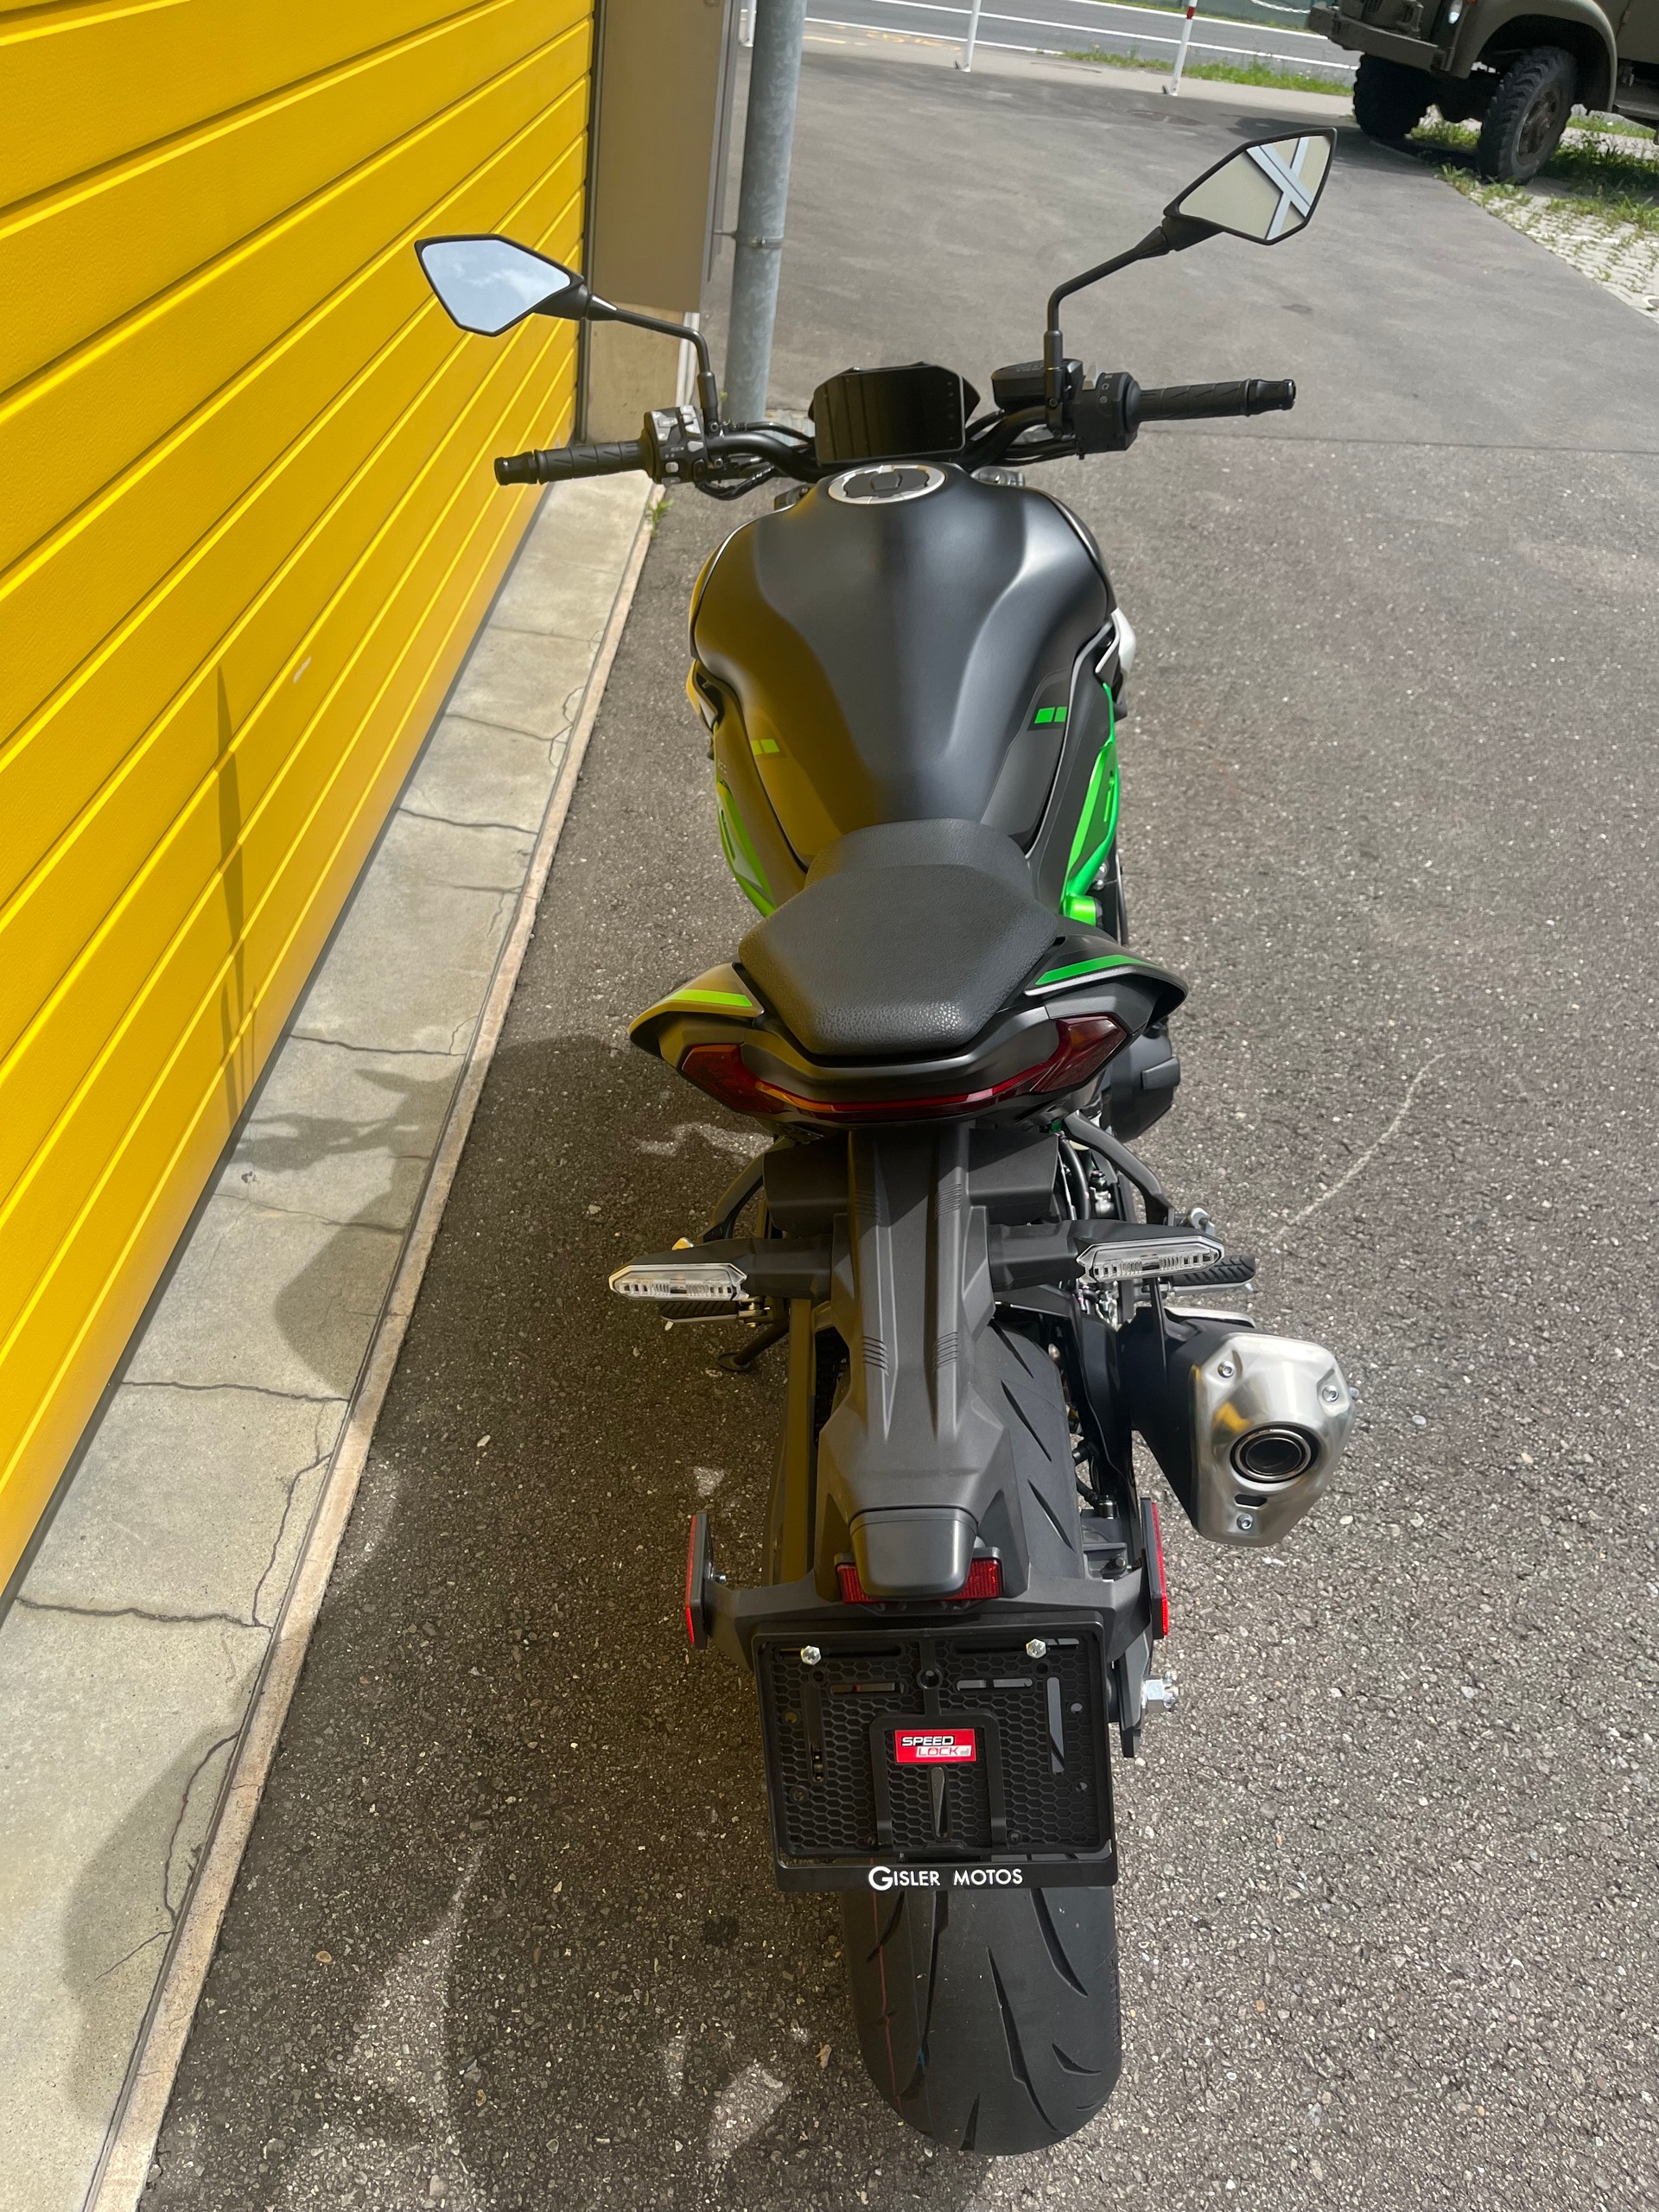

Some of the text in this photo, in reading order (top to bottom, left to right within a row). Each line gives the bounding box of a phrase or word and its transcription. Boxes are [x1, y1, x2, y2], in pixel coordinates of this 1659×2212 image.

[901, 1736, 955, 1746] SPEED
[918, 1746, 958, 1757] LOCK
[868, 1866, 1024, 1891] GISLER MOTOS
